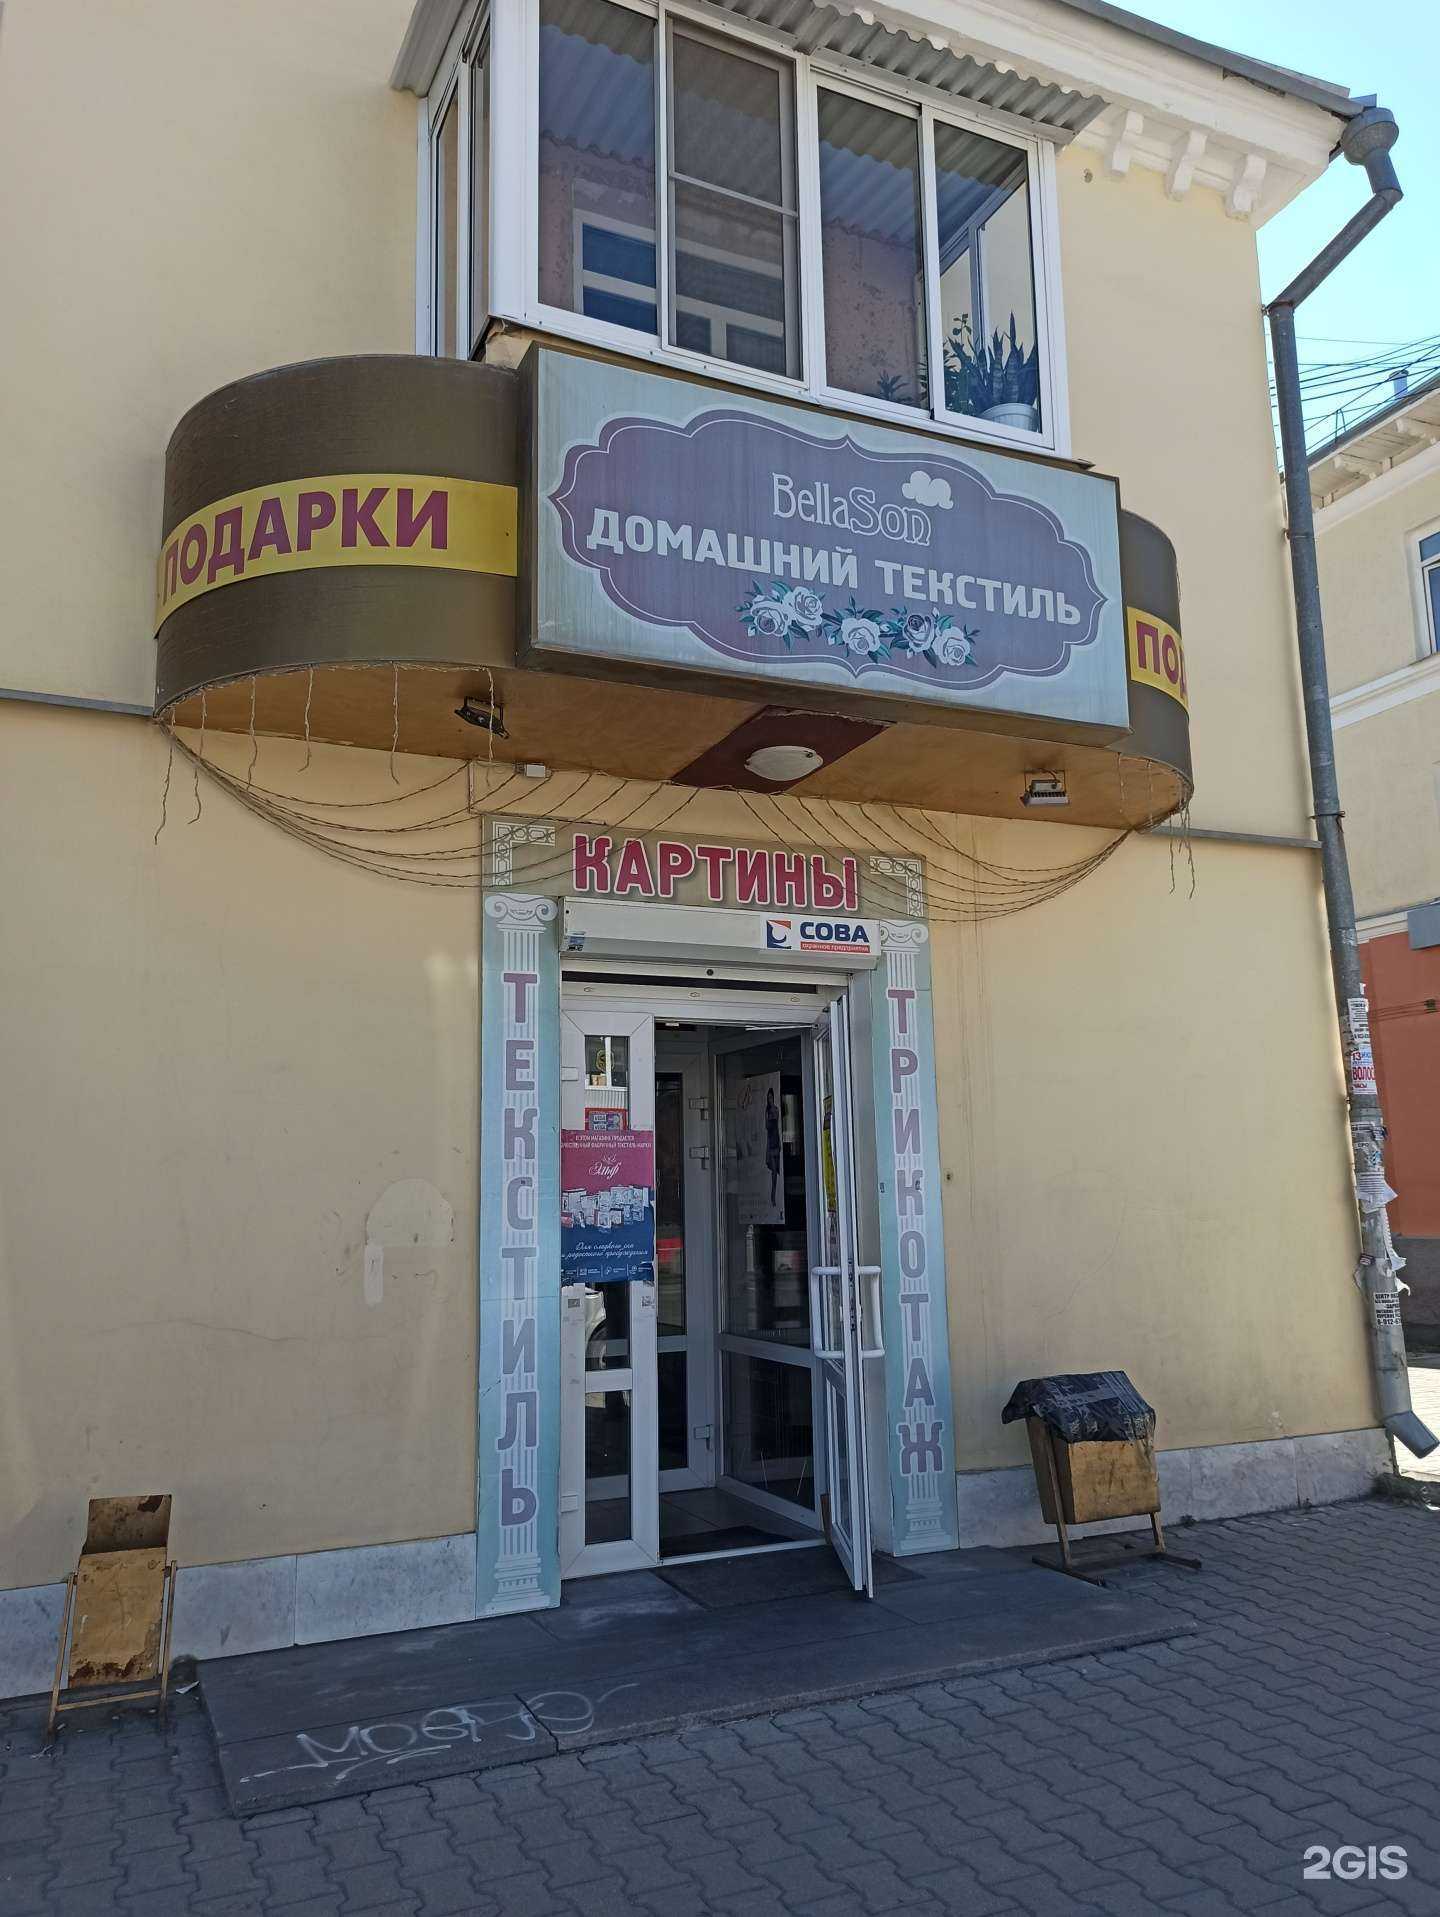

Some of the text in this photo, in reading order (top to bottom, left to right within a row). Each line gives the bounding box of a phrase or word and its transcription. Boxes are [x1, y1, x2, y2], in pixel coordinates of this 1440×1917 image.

[163, 487, 449, 606] ПОДАРКИ
[586, 507, 1081, 625] ДОМАШНИЙ ТЕКСТИЛЬ
[772, 472, 932, 547] BellaSon
[572, 833, 860, 911] КАРТИНЫ
[800, 922, 870, 943] СОВА
[497, 972, 540, 1530] ТЕКСТИЛЬ
[886, 988, 944, 1477] ТРИКОТАЖ
